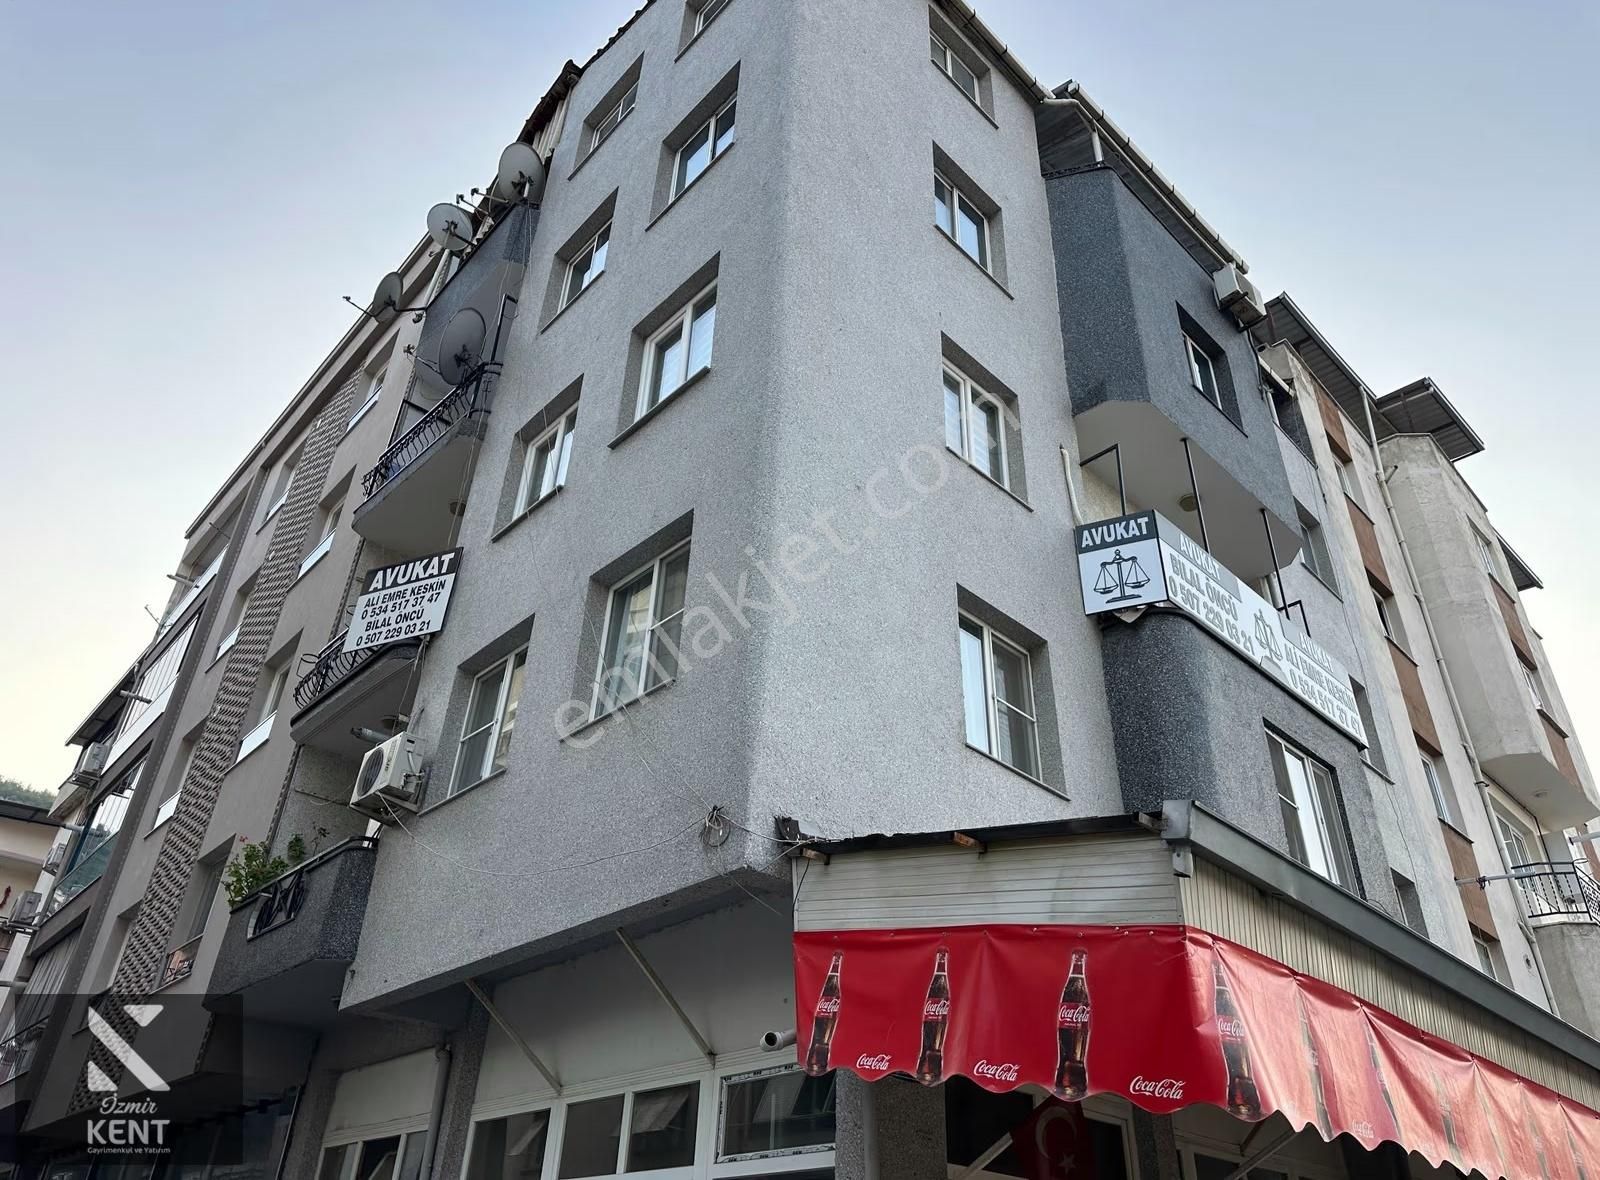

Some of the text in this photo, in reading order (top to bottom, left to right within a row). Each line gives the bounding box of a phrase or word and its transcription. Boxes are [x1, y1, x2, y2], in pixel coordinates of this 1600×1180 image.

[1081, 517, 1149, 548] AVUKAT
[1180, 533, 1220, 580] AVUKAT
[368, 552, 455, 592] AVUKAT
[364, 578, 446, 609] ALİ EMRE KESKİN
[1169, 552, 1239, 622] BİLAL ÖNCÜ
[361, 592, 441, 620] 0 534 517 37 47
[365, 605, 425, 632] BİLAL ÖNCÜ
[1168, 575, 1255, 656] 0 507 229 03 21
[356, 620, 431, 646] 0 507 229 03 21
[1289, 668, 1298, 690] 0
[1298, 674, 1319, 705] 534
[1317, 689, 1336, 719] 517
[1336, 704, 1350, 728] 37
[818, 998, 840, 1013] Coca-Cola
[924, 1000, 950, 1016] Coca-Cola
[1059, 1005, 1090, 1022] Coca-Cola
[856, 1053, 892, 1071] Coca-Cola
[973, 1059, 1021, 1082] Coca-Cola
[1129, 1075, 1187, 1100] Coca-Cola
